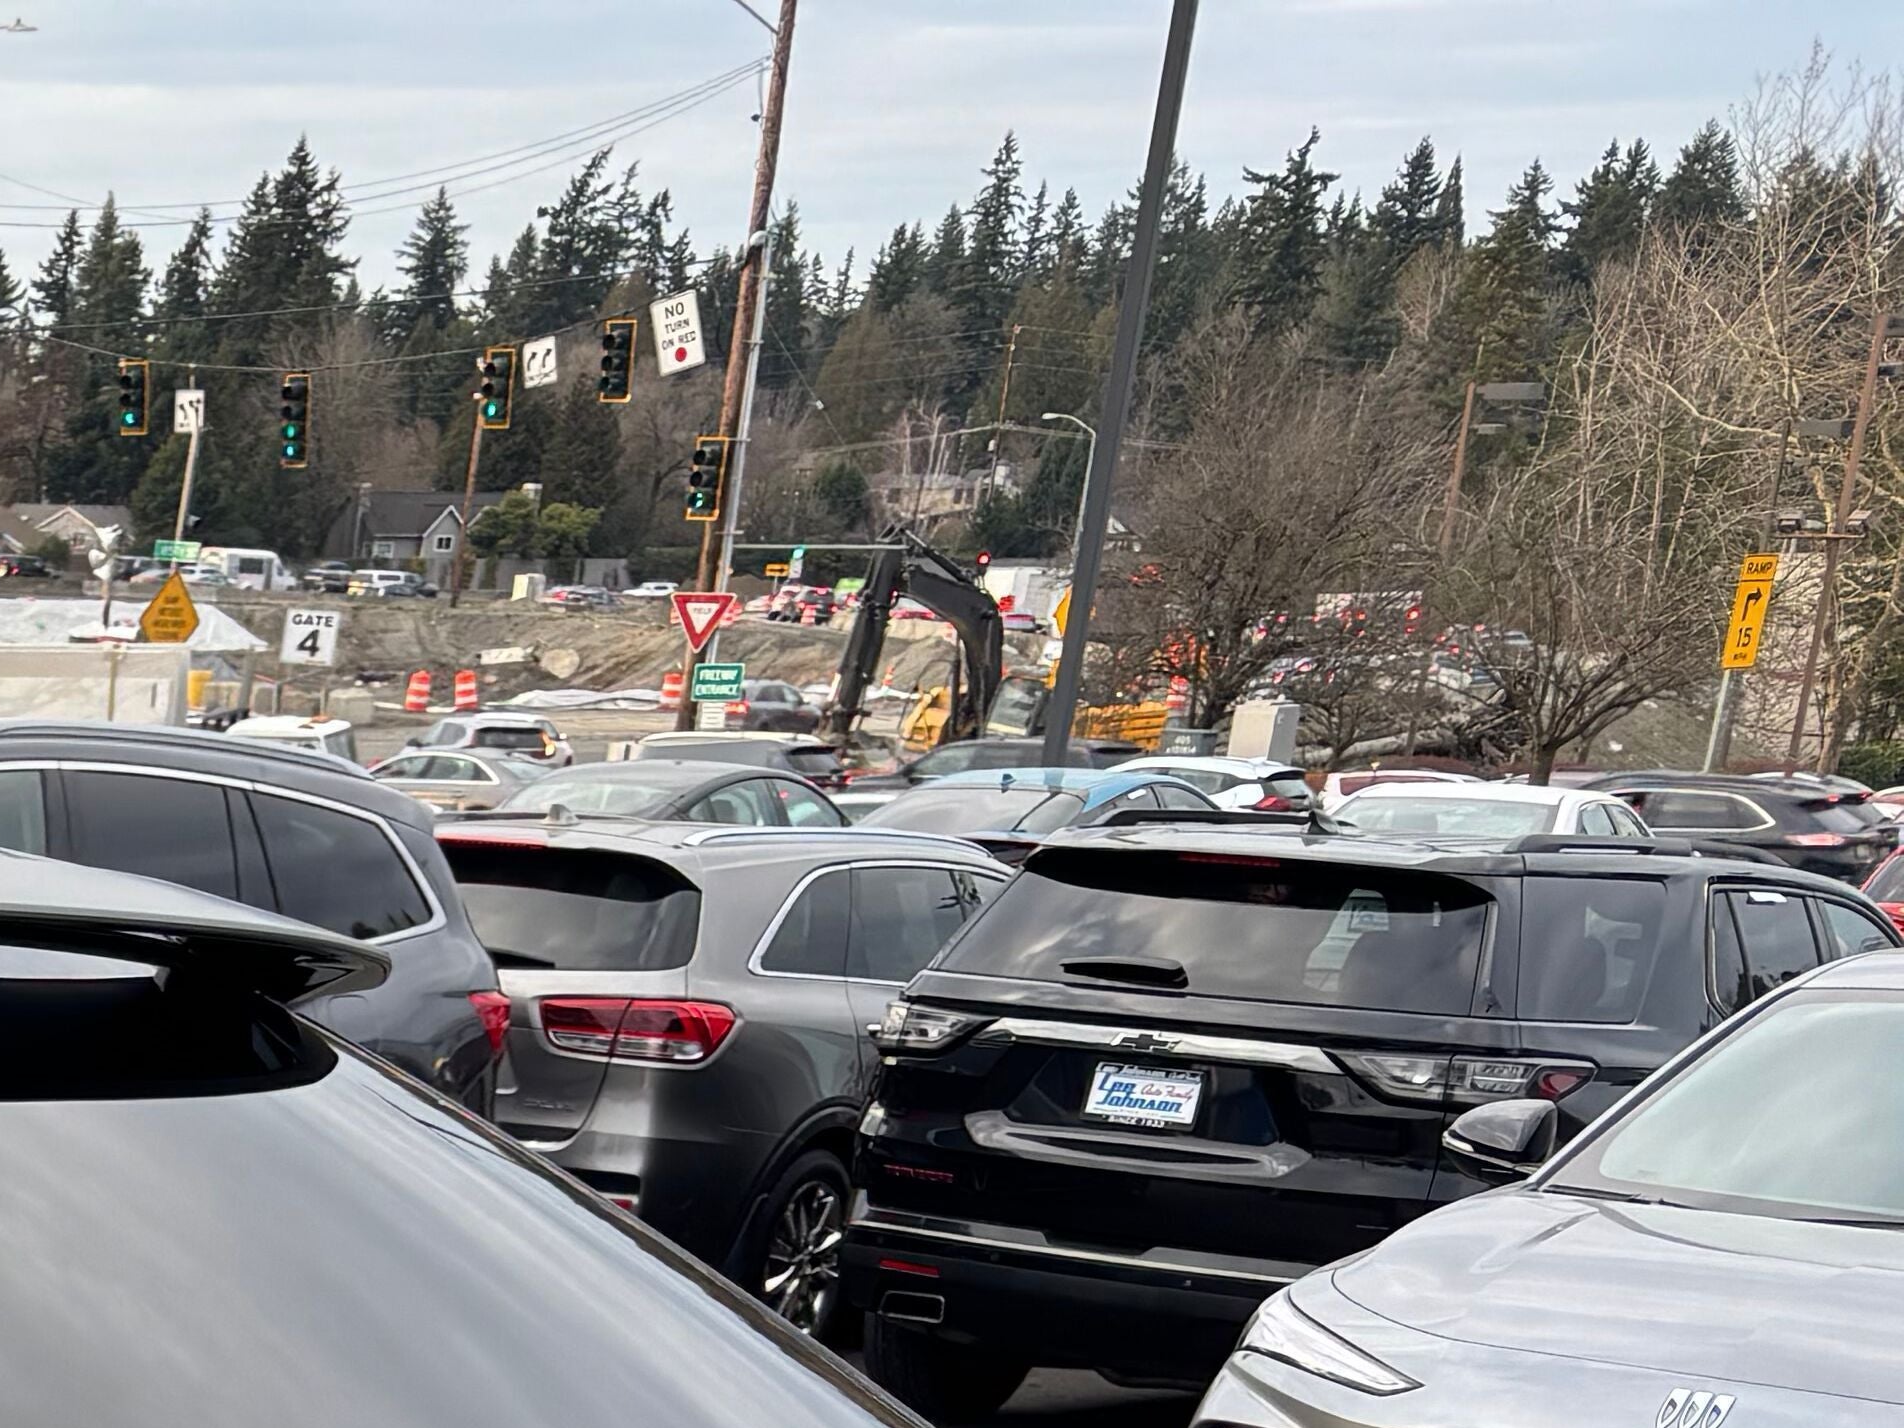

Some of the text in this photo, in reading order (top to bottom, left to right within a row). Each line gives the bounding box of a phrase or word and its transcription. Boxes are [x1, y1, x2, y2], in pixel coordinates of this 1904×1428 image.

[665, 302, 684, 319] NO
[665, 318, 690, 334] TURN
[662, 339, 674, 351] ON
[1747, 562, 1773, 574] RAMP
[292, 613, 334, 628] GATE
[296, 629, 320, 657] 4
[1736, 627, 1753, 648] 15
